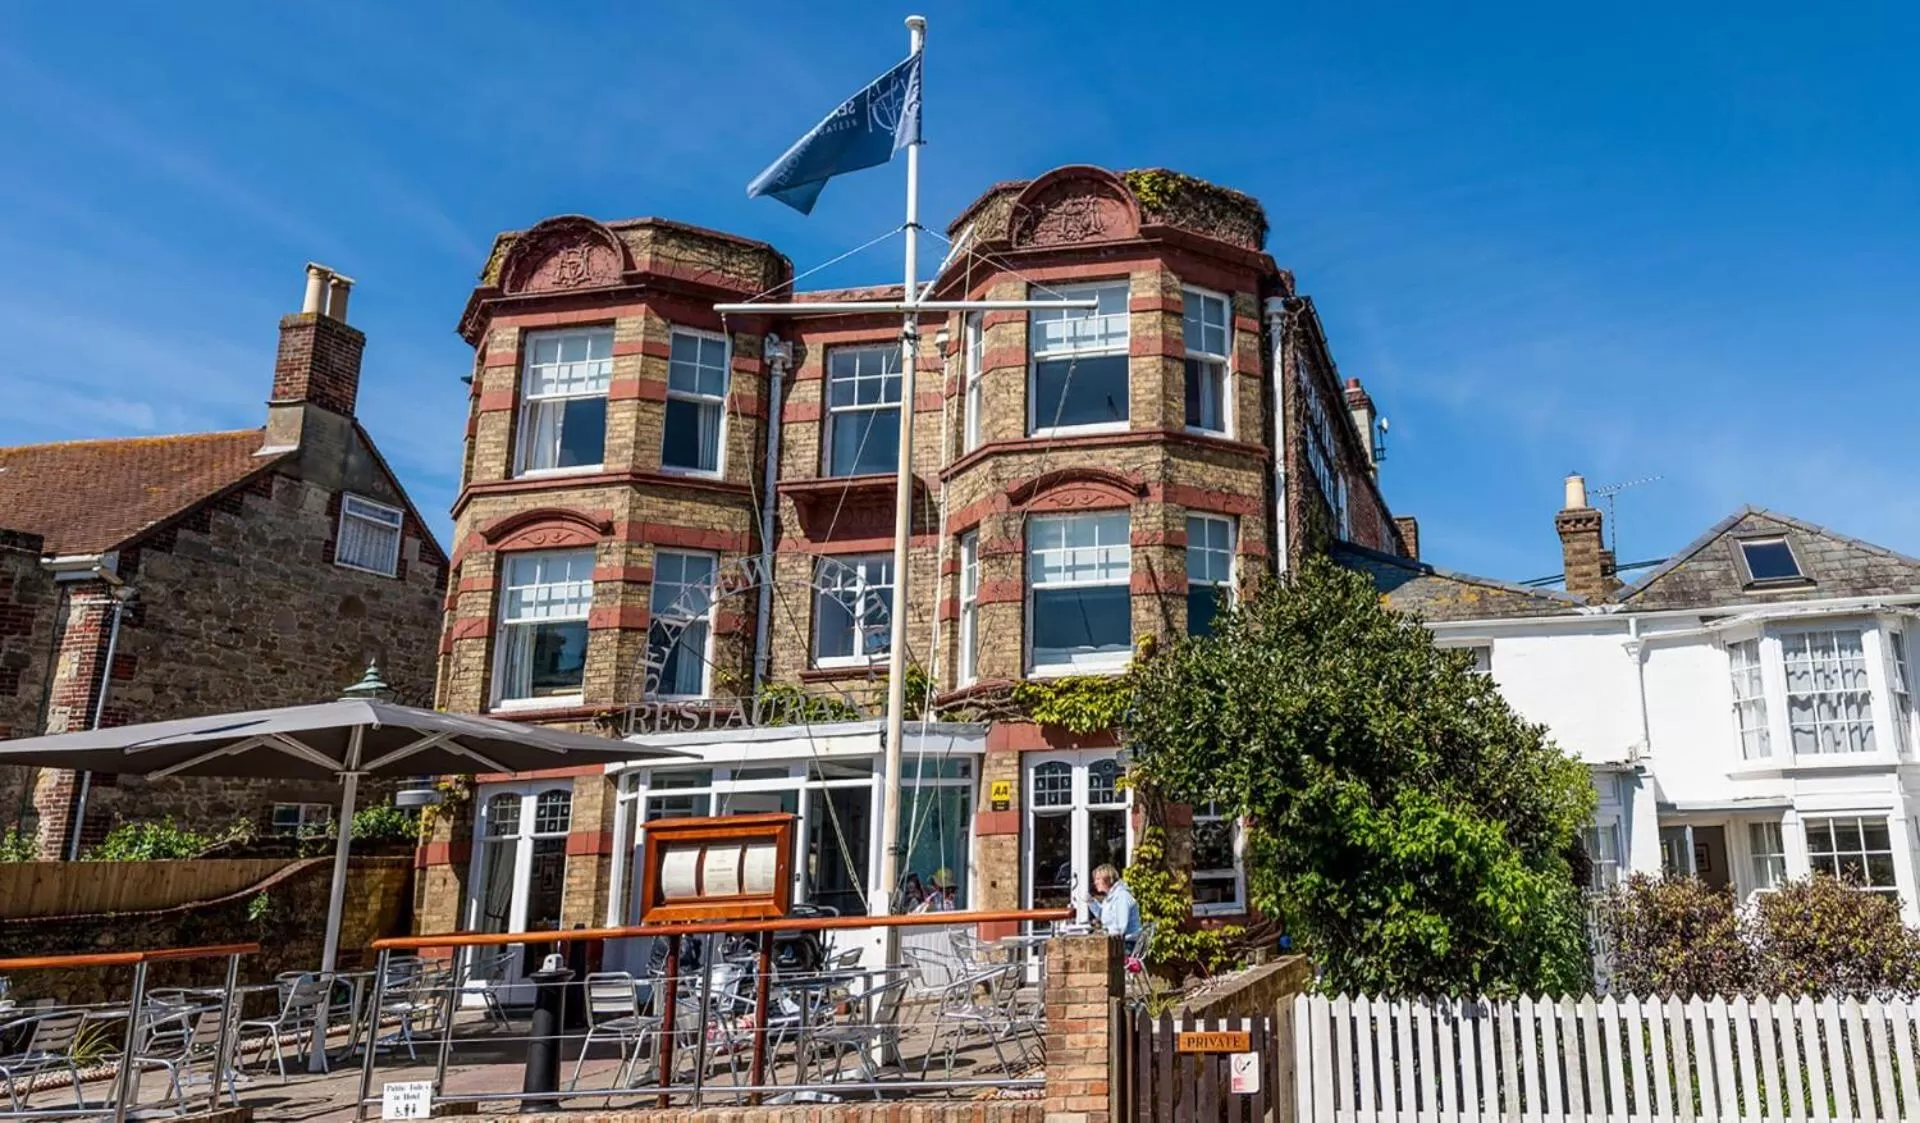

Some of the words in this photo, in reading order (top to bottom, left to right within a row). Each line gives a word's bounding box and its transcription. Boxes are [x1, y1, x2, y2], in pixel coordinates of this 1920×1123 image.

[626, 692, 888, 736] RESTAURAN
[994, 785, 1008, 796] AA
[1187, 1036, 1240, 1048] PRIVATE
